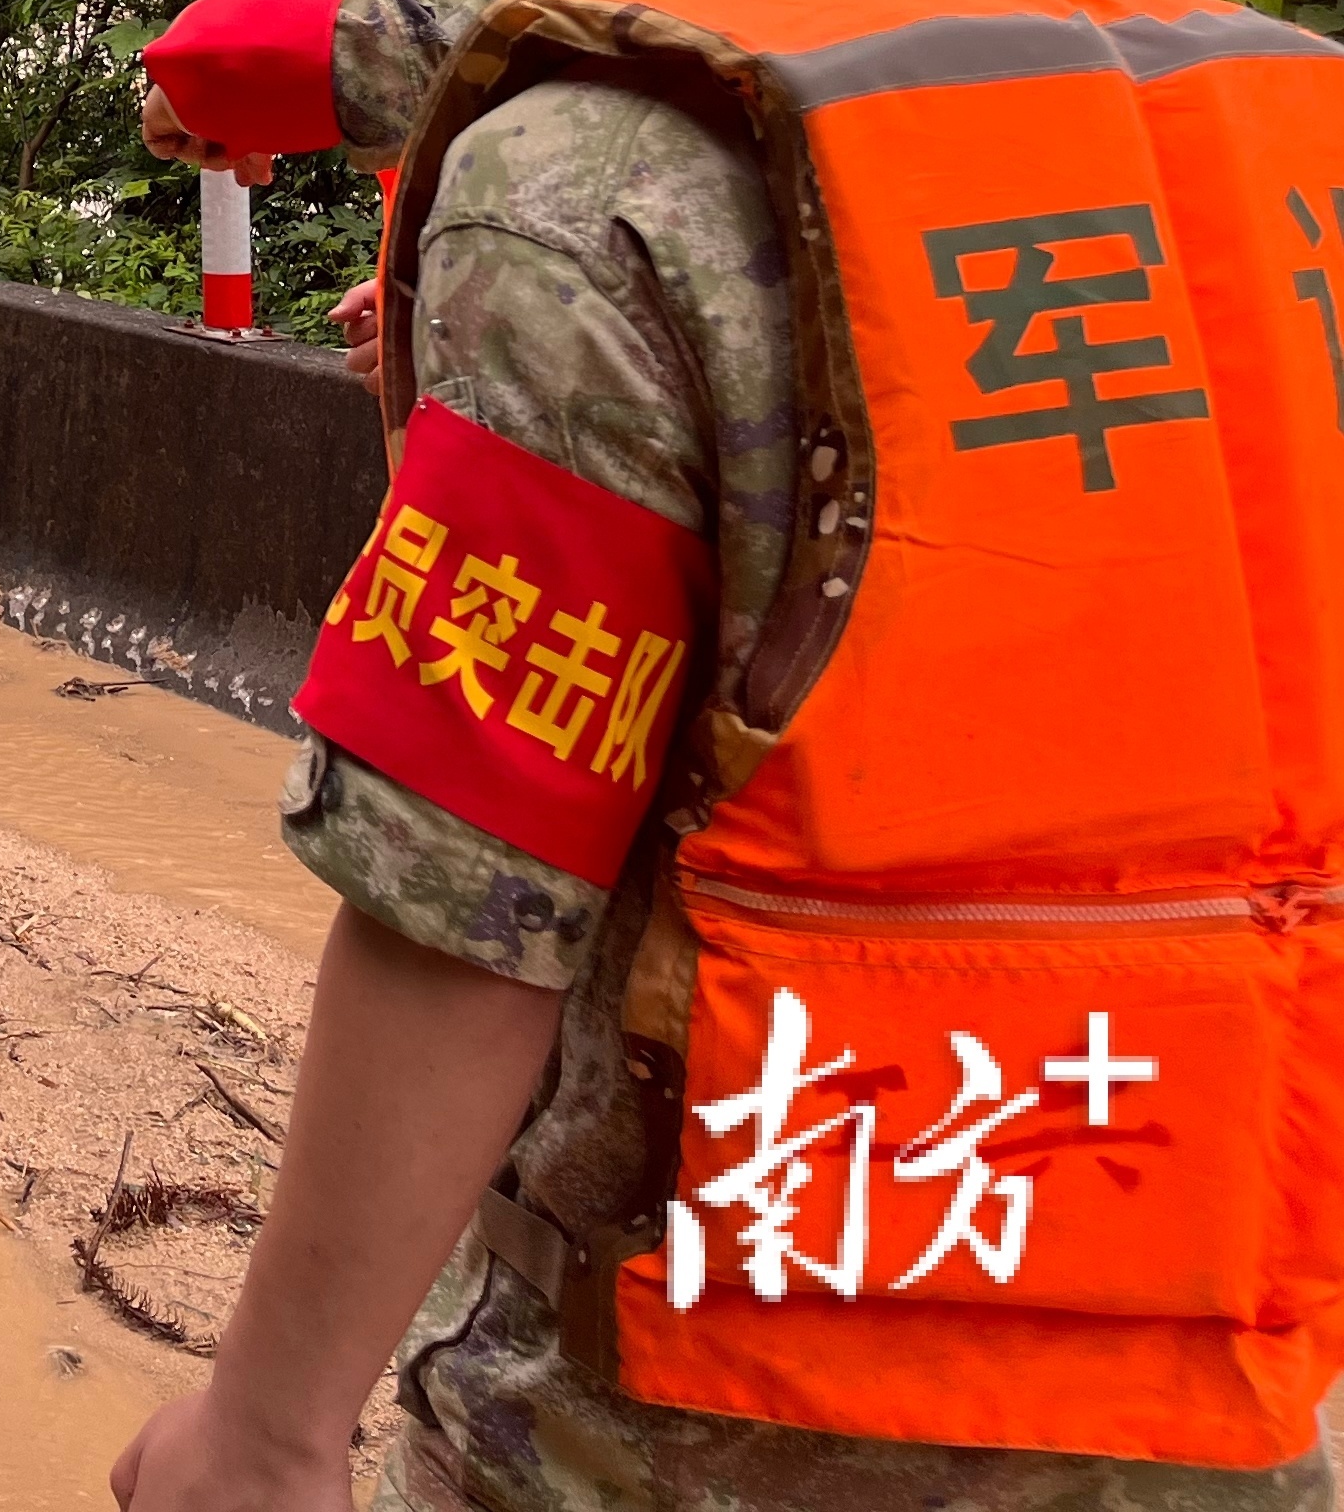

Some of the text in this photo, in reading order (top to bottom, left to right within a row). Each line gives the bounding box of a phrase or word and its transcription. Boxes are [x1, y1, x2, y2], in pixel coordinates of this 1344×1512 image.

[920, 185, 1344, 494] 军
[325, 503, 687, 793] 员突击队
